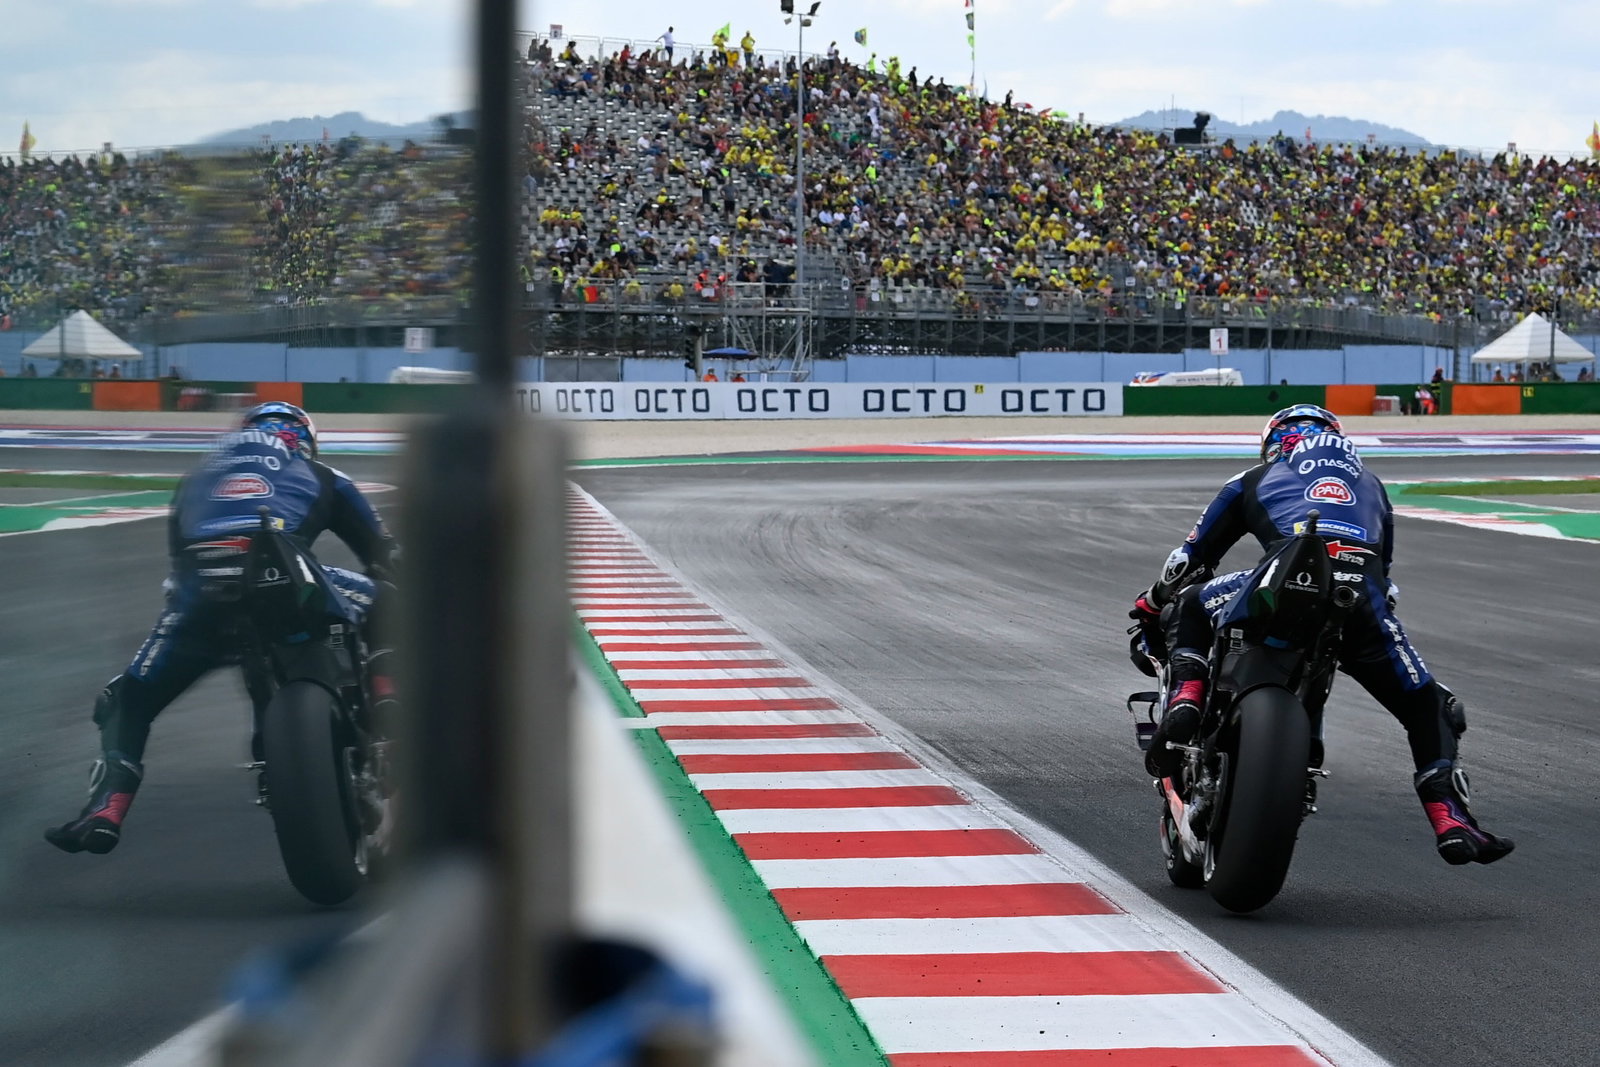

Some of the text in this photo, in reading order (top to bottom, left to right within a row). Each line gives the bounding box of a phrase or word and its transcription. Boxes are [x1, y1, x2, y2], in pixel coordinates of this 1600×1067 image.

[516, 389, 542, 413] TO
[556, 389, 614, 413] OCTO
[635, 389, 710, 413] OCTO
[737, 389, 830, 412] OCTO
[863, 388, 966, 412] OCTO
[1001, 388, 1105, 412] OCTO
[1316, 485, 1346, 499] PATA
